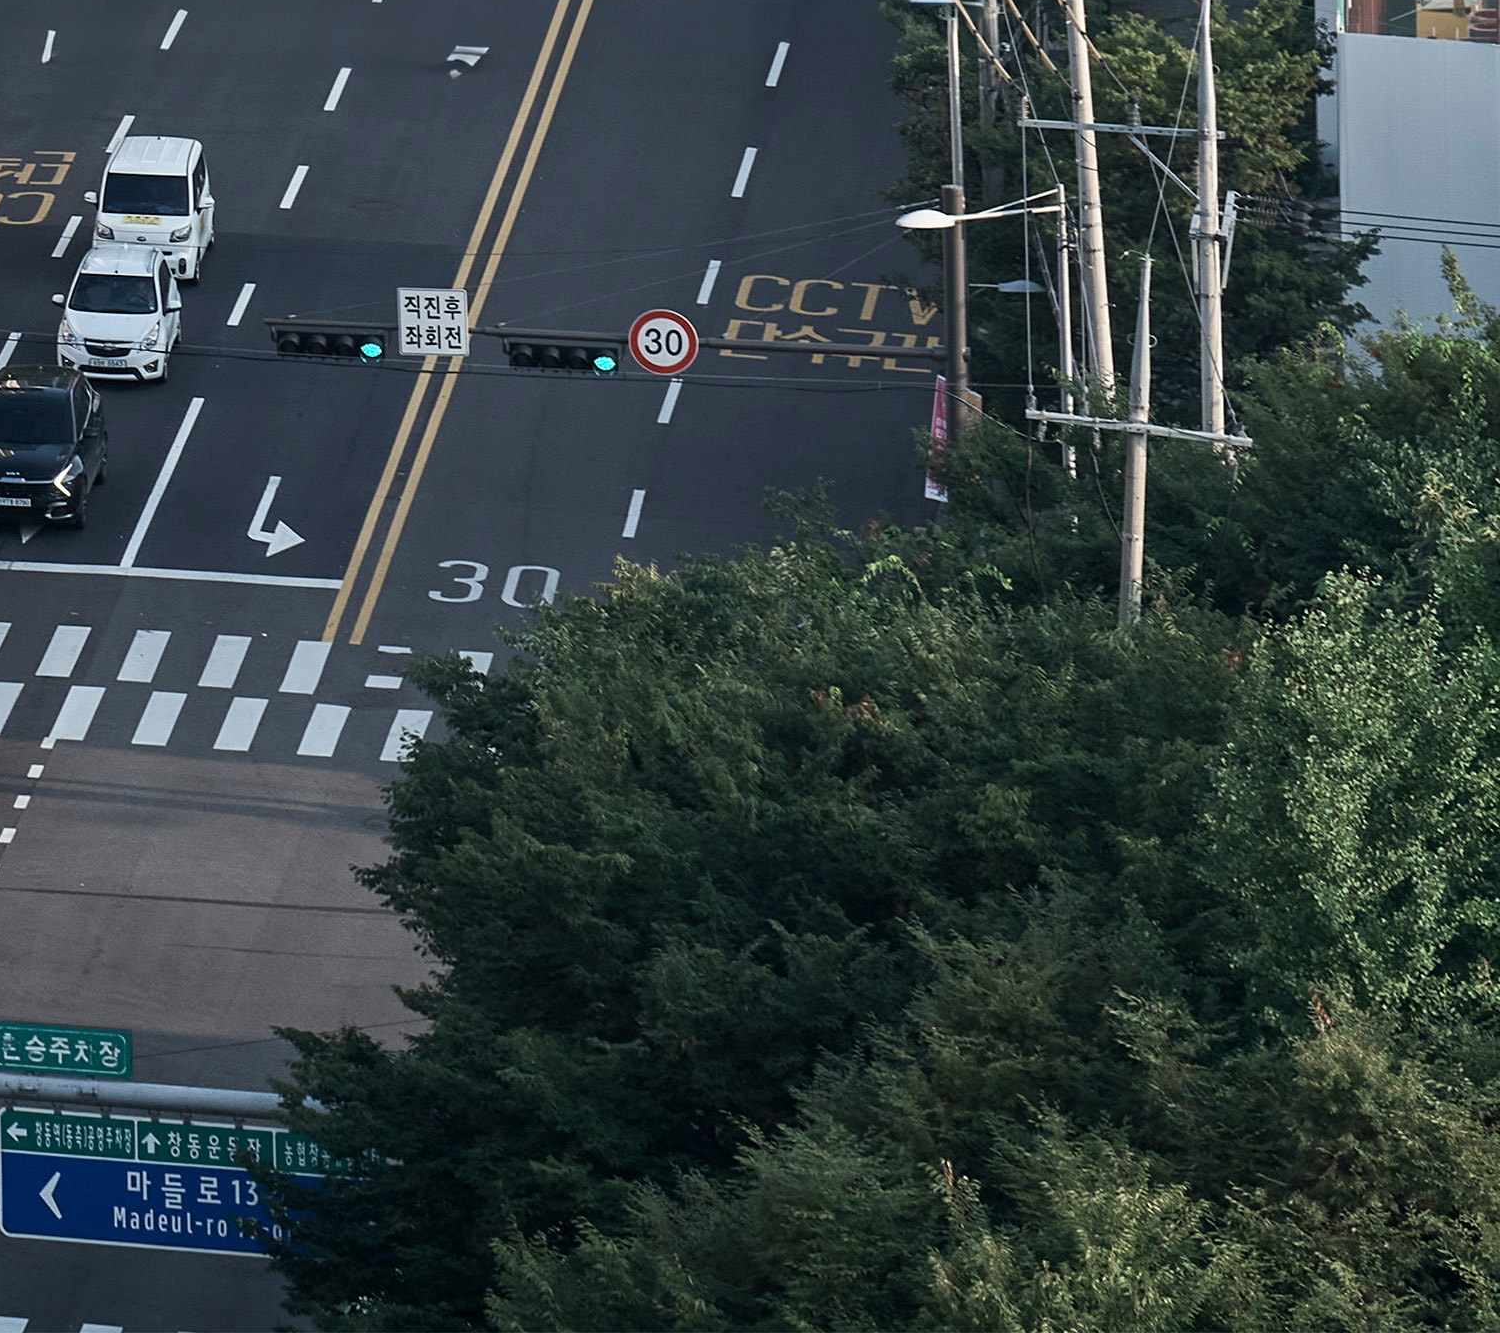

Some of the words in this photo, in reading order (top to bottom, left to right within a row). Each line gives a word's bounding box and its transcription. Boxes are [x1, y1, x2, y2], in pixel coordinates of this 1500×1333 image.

[403, 294, 463, 320] 직진후
[734, 274, 940, 326] CCTV
[404, 324, 463, 351] 좌회전
[644, 327, 683, 356] 30
[427, 559, 562, 609] 30
[167, 1130, 262, 1163] 창동운동장
[125, 1169, 223, 1211] 마들로
[231, 1178, 260, 1207] 13
[112, 1205, 228, 1239] Madeul-ro
